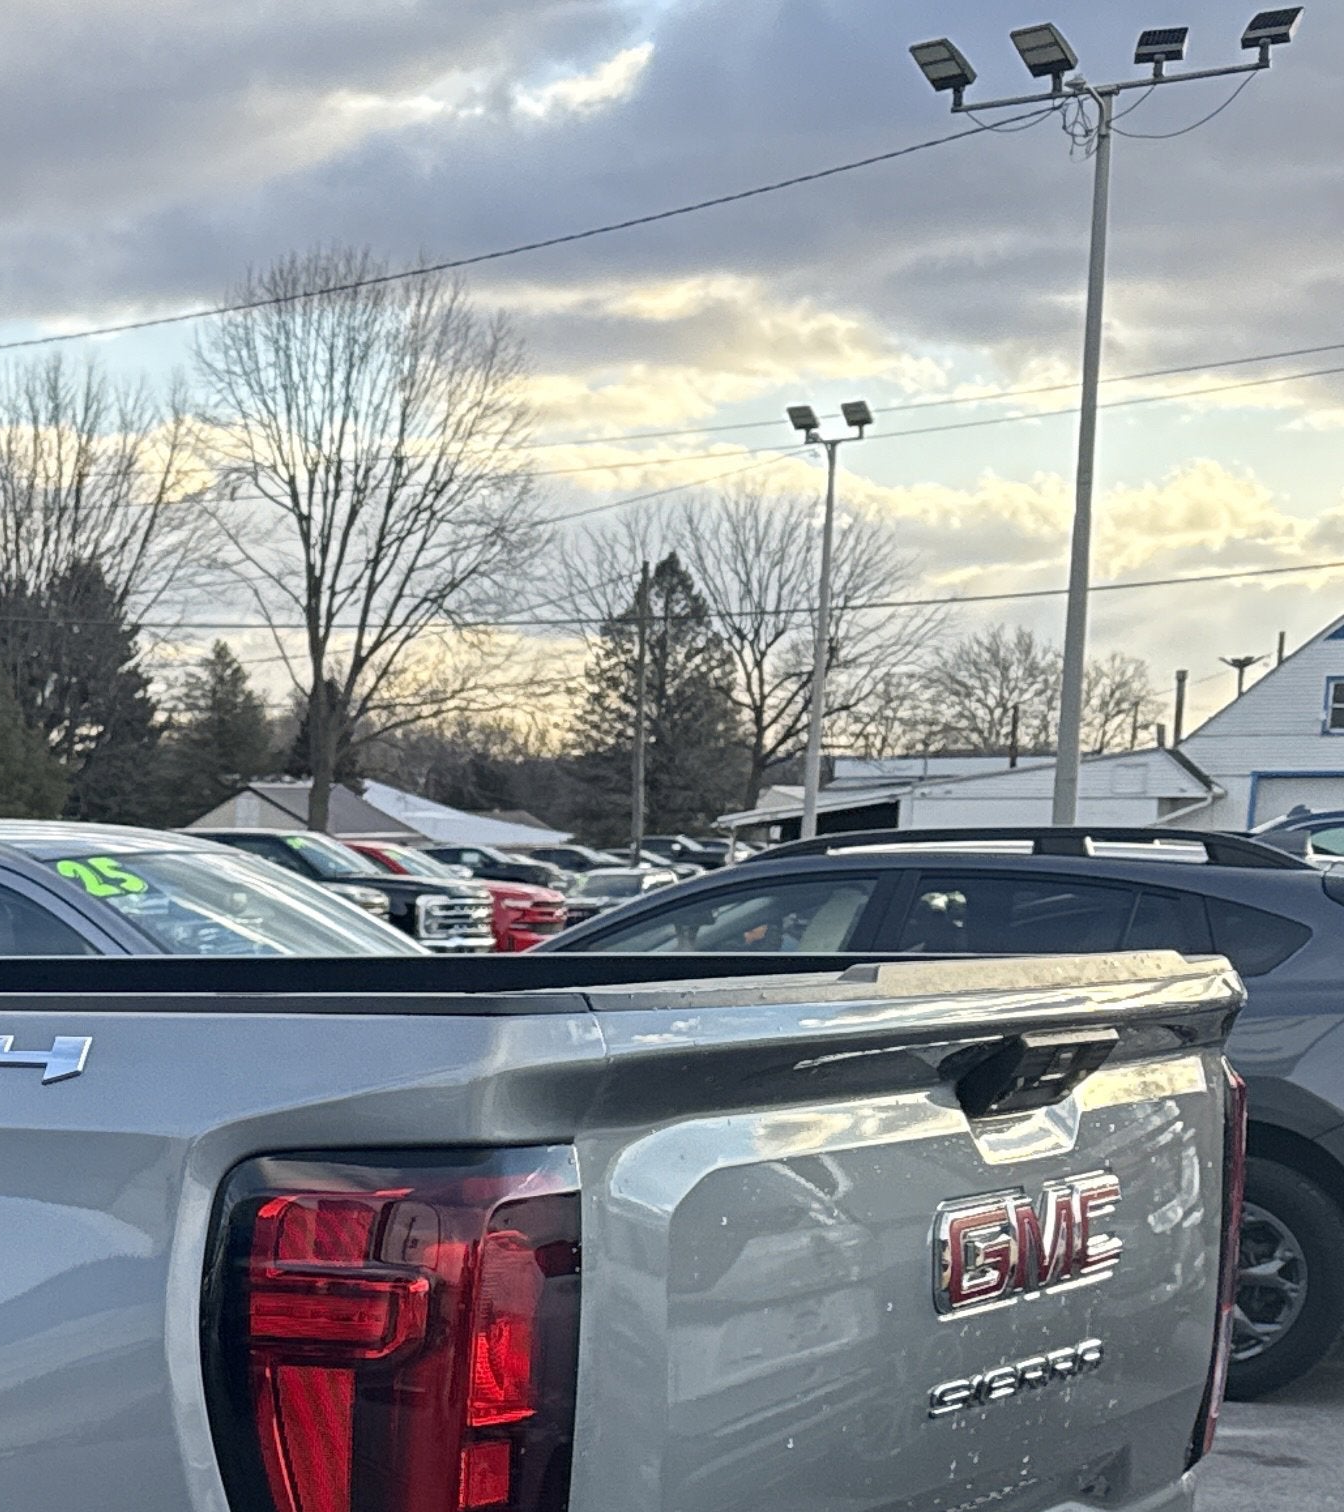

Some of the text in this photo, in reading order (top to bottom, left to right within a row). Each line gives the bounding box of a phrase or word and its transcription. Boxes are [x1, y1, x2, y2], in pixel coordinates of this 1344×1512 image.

[56, 857, 148, 896] 25
[932, 1168, 1123, 1322] GMC
[928, 1338, 1104, 1419] SIERRA
